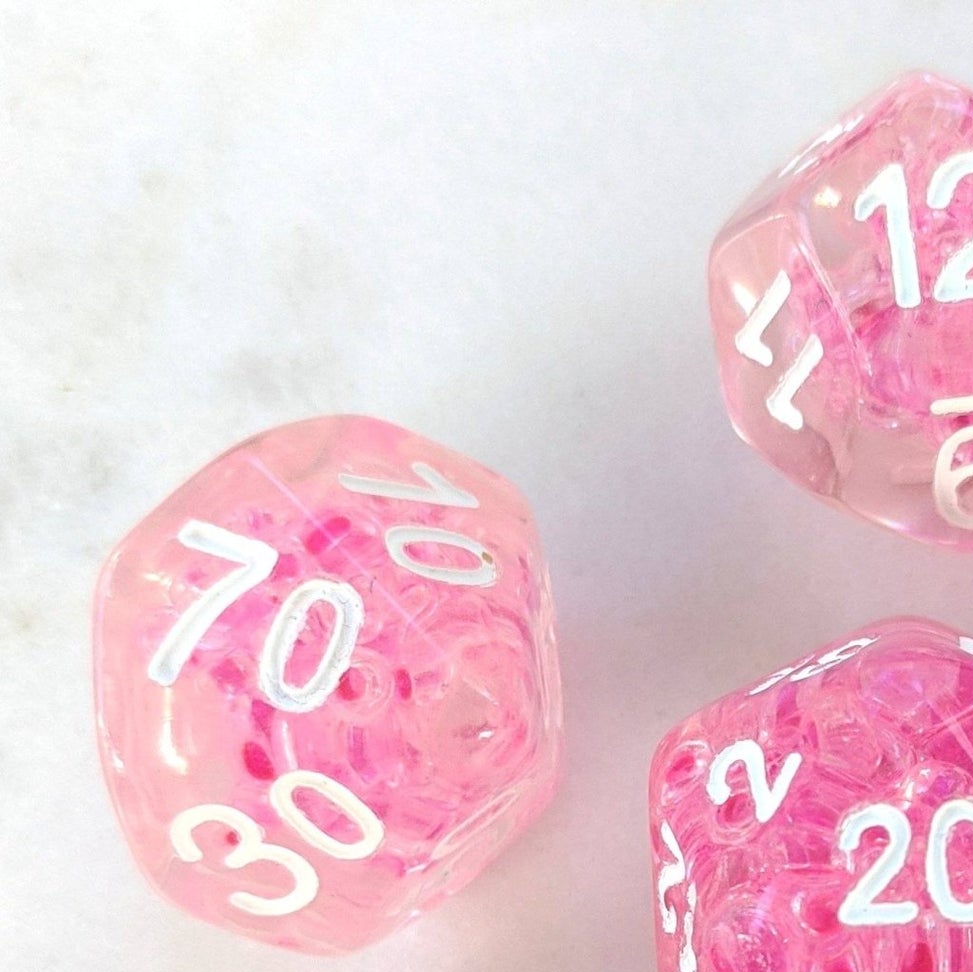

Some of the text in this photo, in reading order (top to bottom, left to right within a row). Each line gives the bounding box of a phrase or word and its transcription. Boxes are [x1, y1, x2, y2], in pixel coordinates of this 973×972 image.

[734, 269, 825, 431] 11
[338, 461, 497, 588] 10
[146, 518, 365, 713] 70
[169, 769, 385, 917] 30
[705, 739, 802, 823] 2
